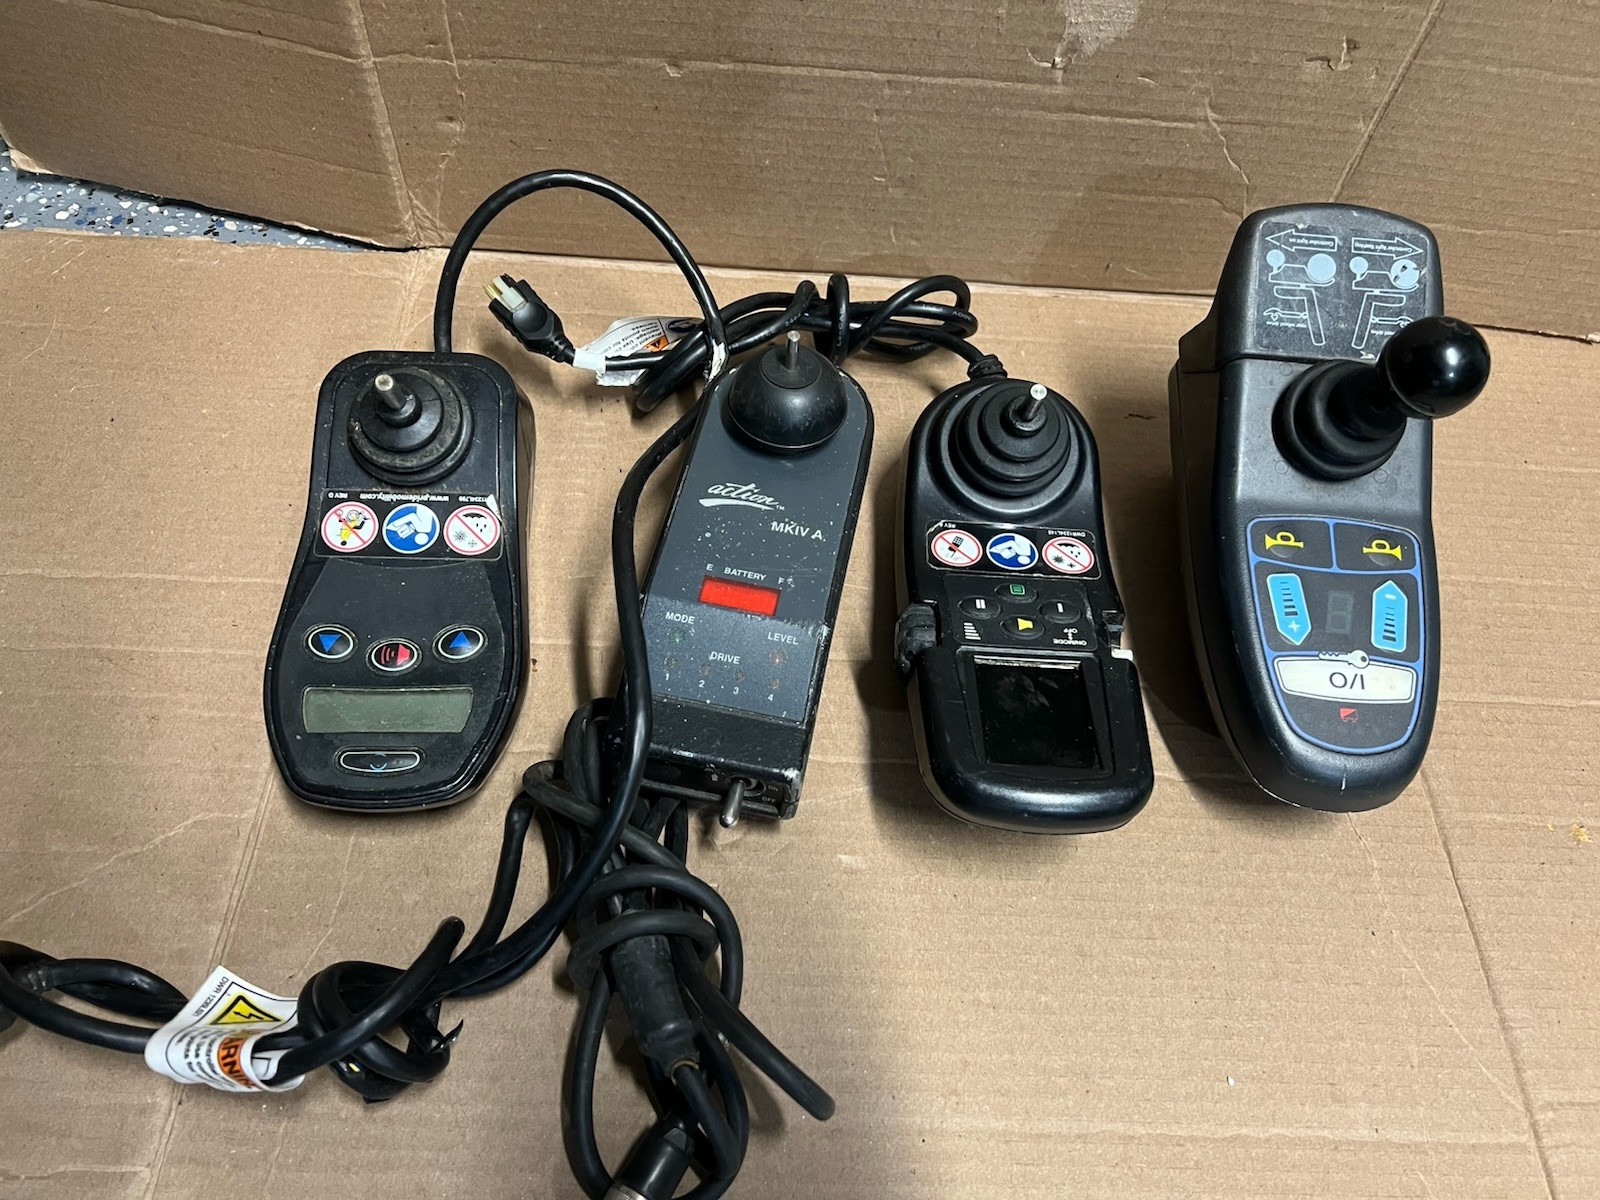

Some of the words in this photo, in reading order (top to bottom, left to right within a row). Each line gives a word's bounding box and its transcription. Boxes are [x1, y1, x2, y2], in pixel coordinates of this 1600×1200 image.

[360, 491, 449, 502] www.pridemobility.com
[707, 483, 779, 506] action
[771, 520, 810, 537] MKIV
[811, 530, 823, 540] A
[724, 567, 766, 581] BATTERY
[665, 611, 695, 625] MODE
[767, 631, 799, 645] LEVEL
[708, 651, 741, 665] DRIVE
[698, 680, 706, 688] 2
[733, 687, 739, 695] 3
